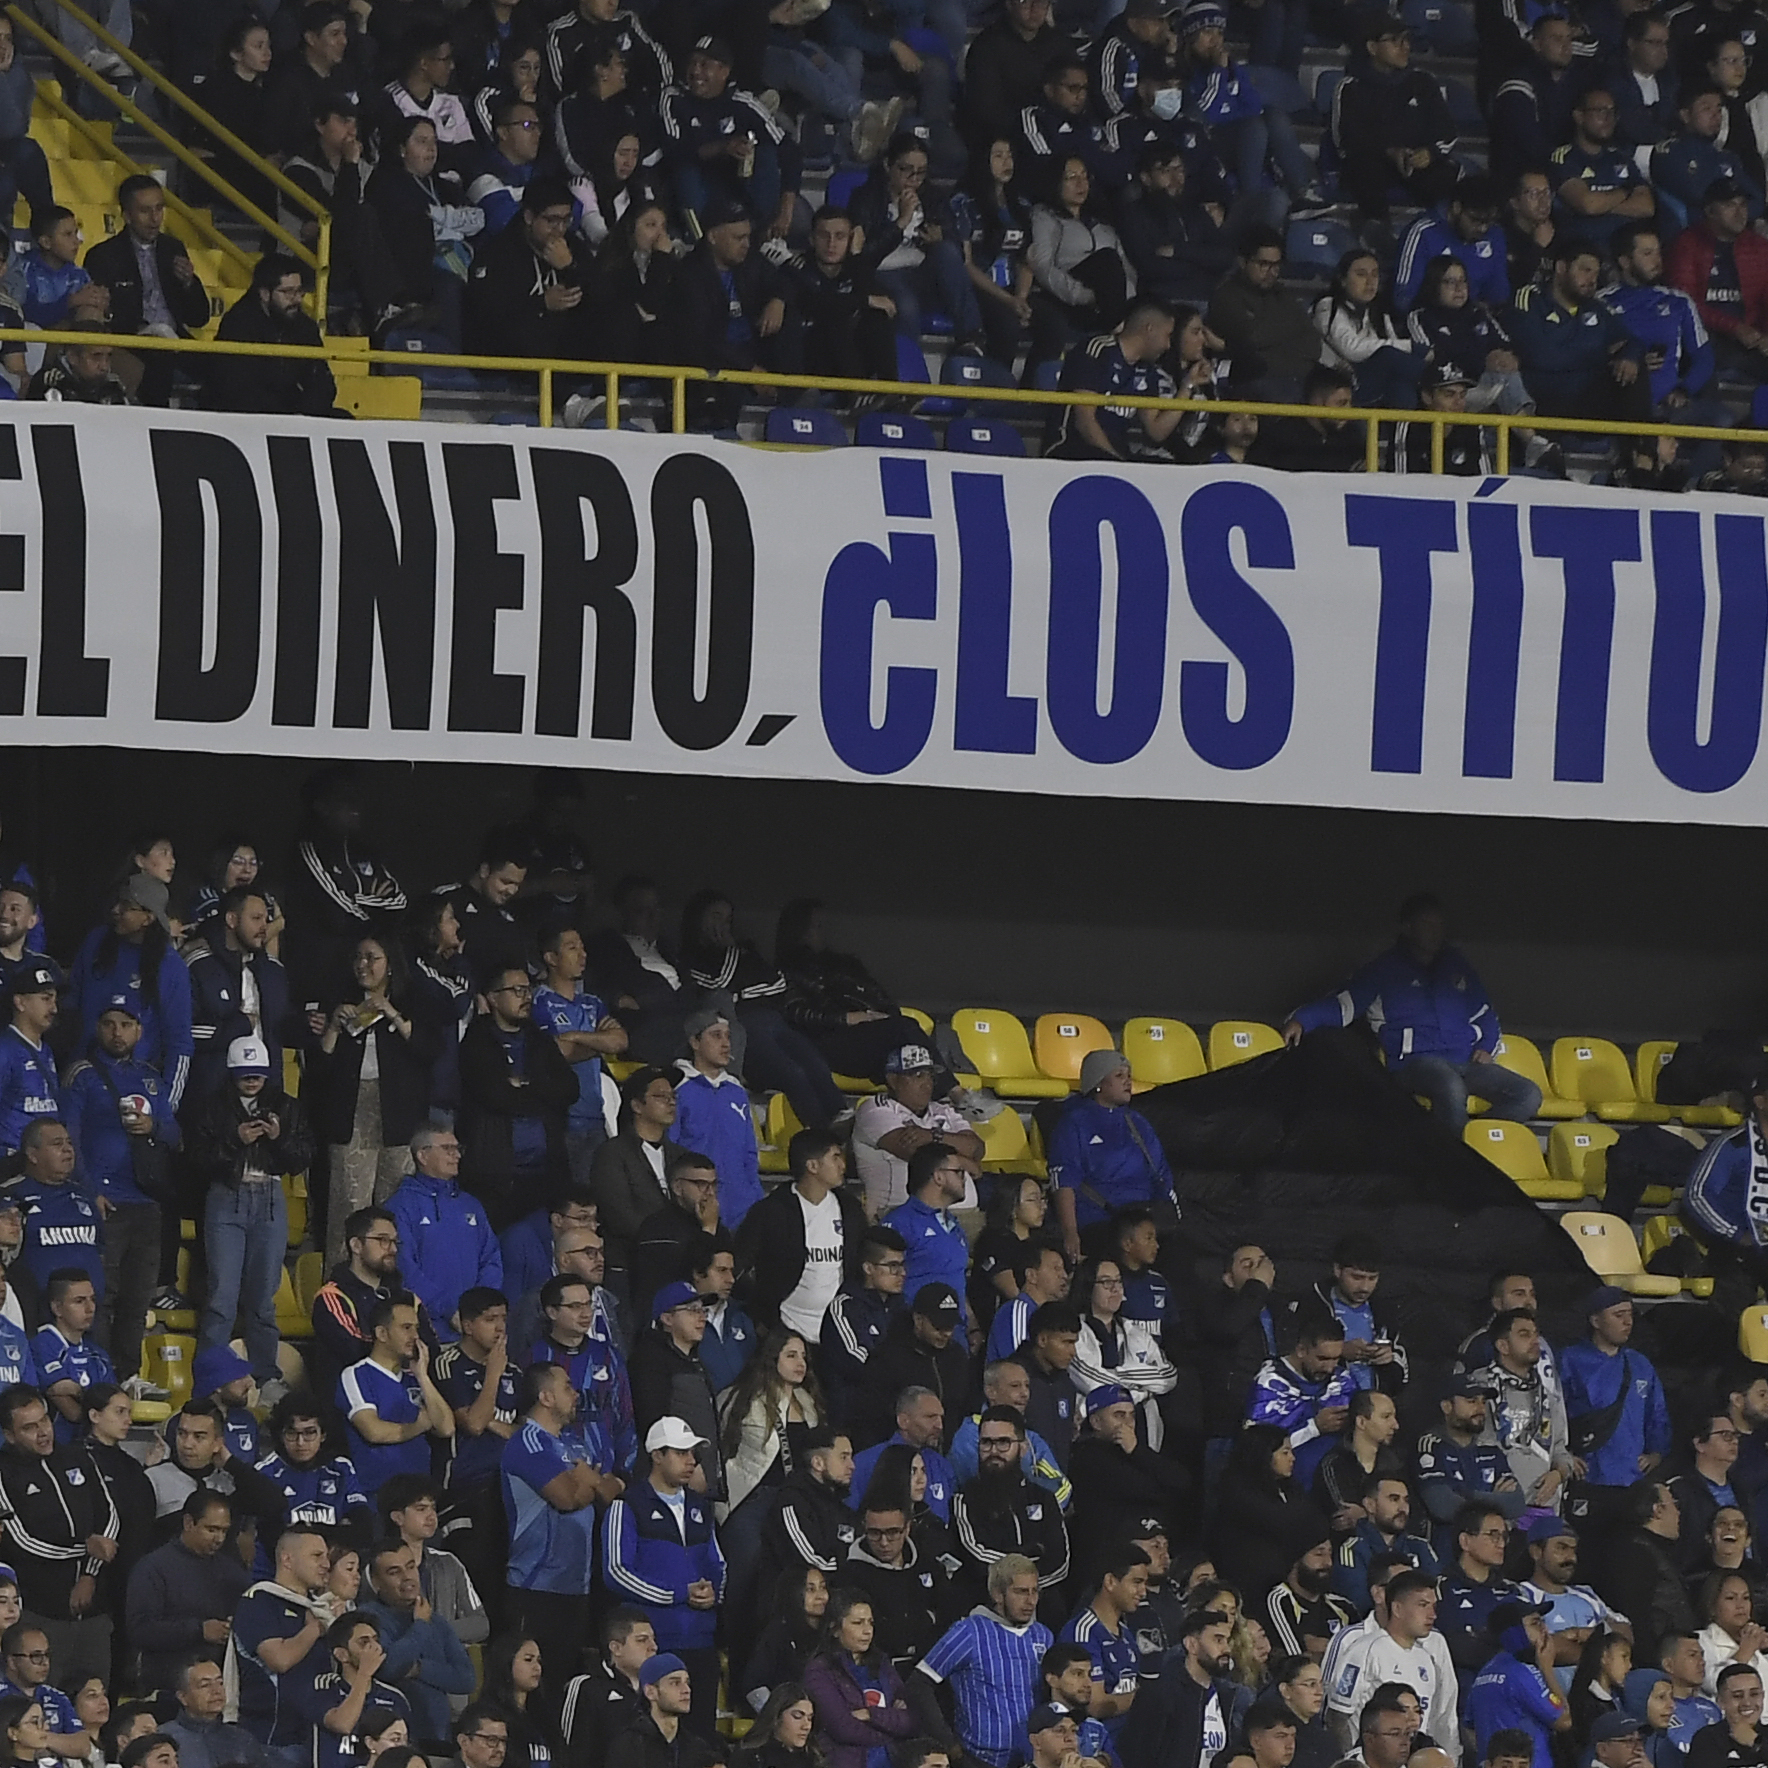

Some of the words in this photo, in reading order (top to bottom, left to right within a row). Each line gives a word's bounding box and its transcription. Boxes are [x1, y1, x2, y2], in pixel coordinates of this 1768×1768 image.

[150, 429, 796, 751] DINERO,
[820, 458, 1296, 775] ¿LOS
[40, 1225, 97, 1246] ANDINA
[805, 1245, 844, 1263] NDINA
[1204, 1731, 1226, 1749] EON
